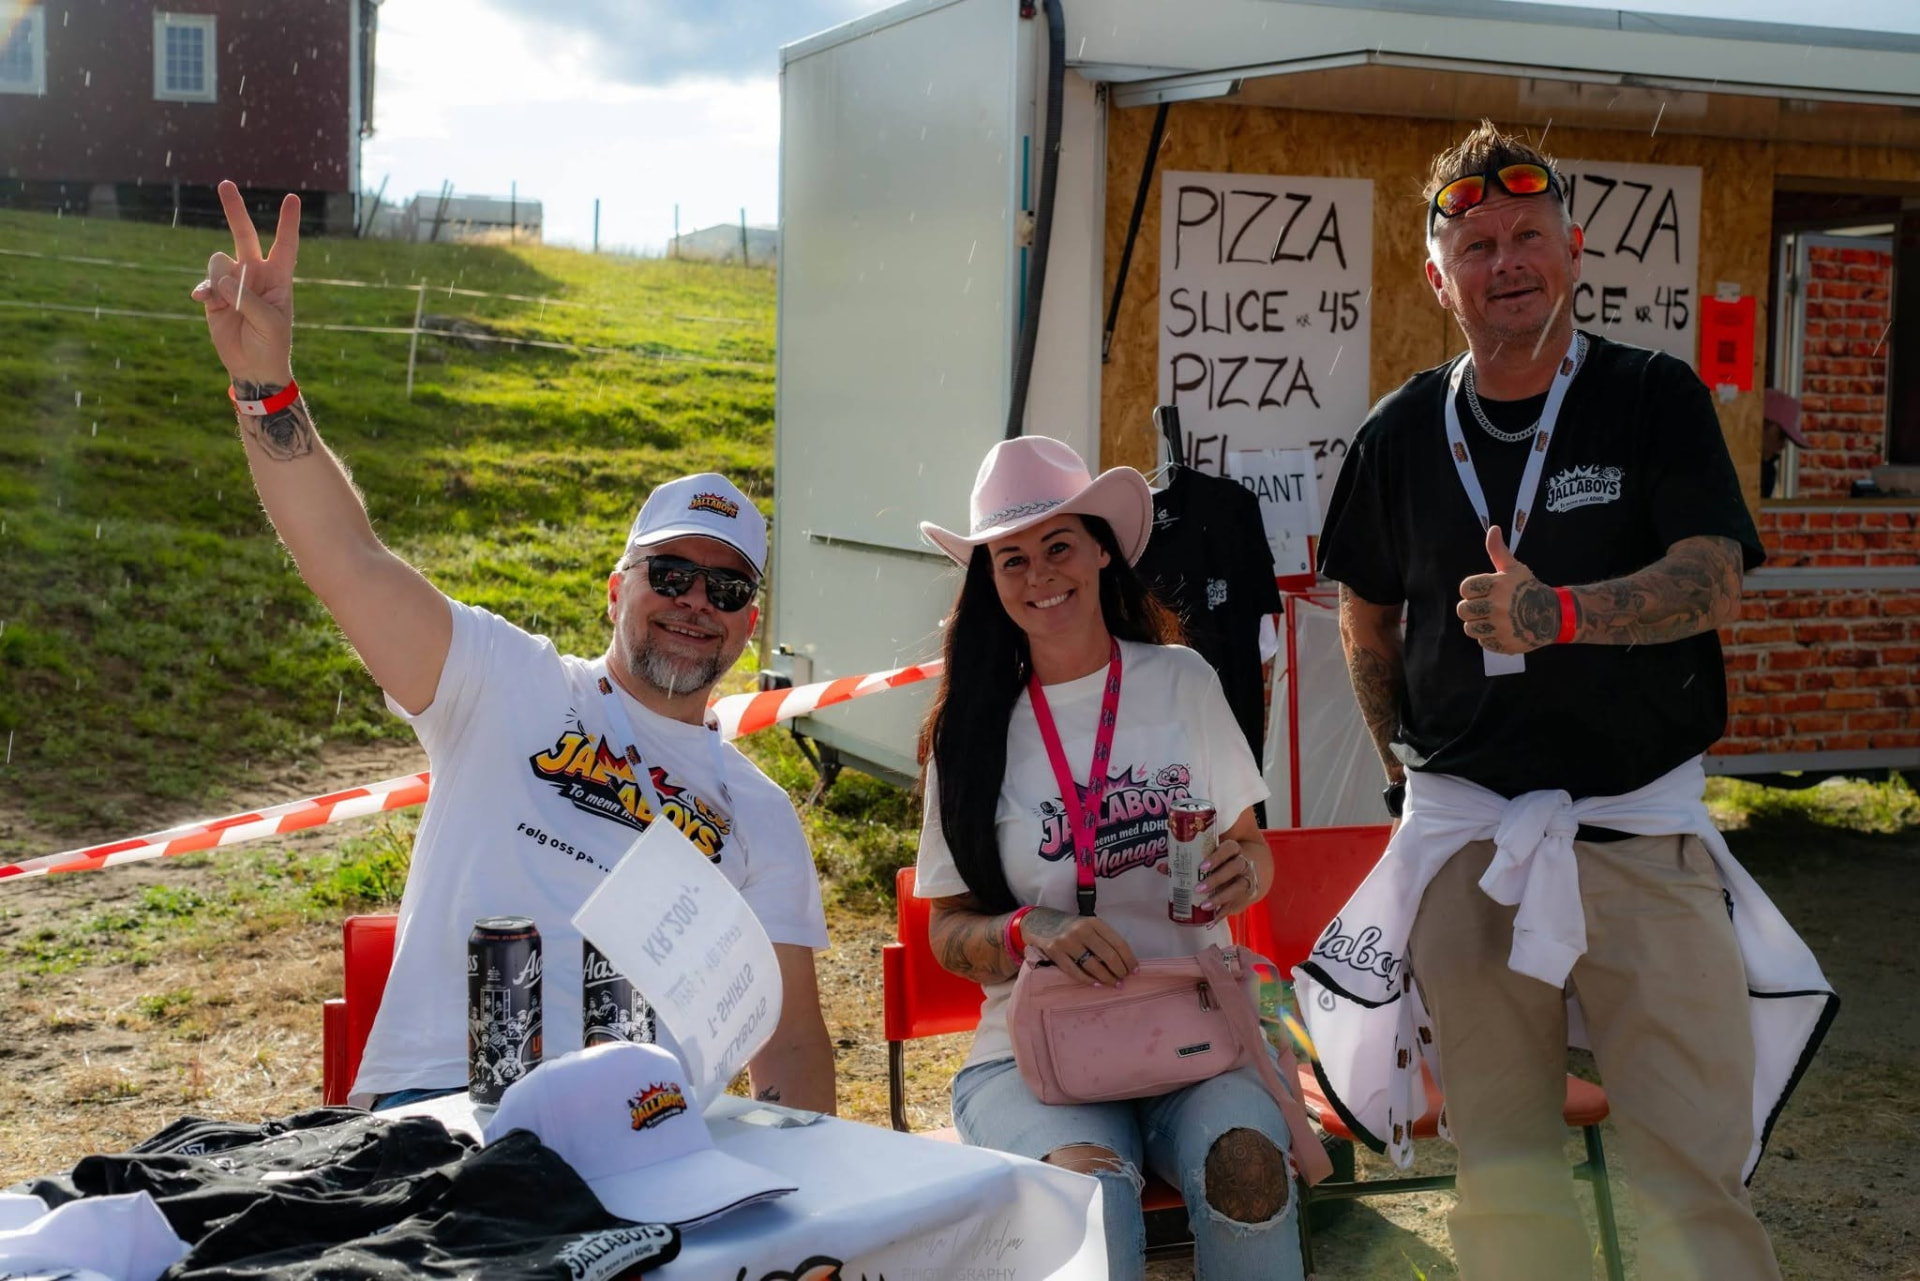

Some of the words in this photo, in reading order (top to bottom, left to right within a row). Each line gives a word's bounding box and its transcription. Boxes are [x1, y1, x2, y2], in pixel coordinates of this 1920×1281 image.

[1174, 185, 1347, 269] PIZZA
[1166, 287, 1289, 338] SLICE
[1318, 289, 1361, 333] 45
[1655, 286, 1689, 330] 45
[1170, 352, 1321, 410] PIZZA
[1242, 473, 1305, 503] PANT
[1547, 479, 1618, 508] JALLABOYS
[689, 498, 737, 518] JALLABOYS
[535, 735, 718, 857] JALAOYS
[569, 783, 584, 798] To
[586, 793, 621, 813] menn
[550, 839, 575, 856] oss
[1094, 830, 1118, 848] enn
[1119, 824, 1140, 839] med
[1094, 836, 1168, 876] Manage
[512, 949, 542, 985] Aa
[583, 952, 617, 980] Aas
[631, 1093, 687, 1130] JALLABOYS
[569, 1226, 666, 1279] JALLABOYS
